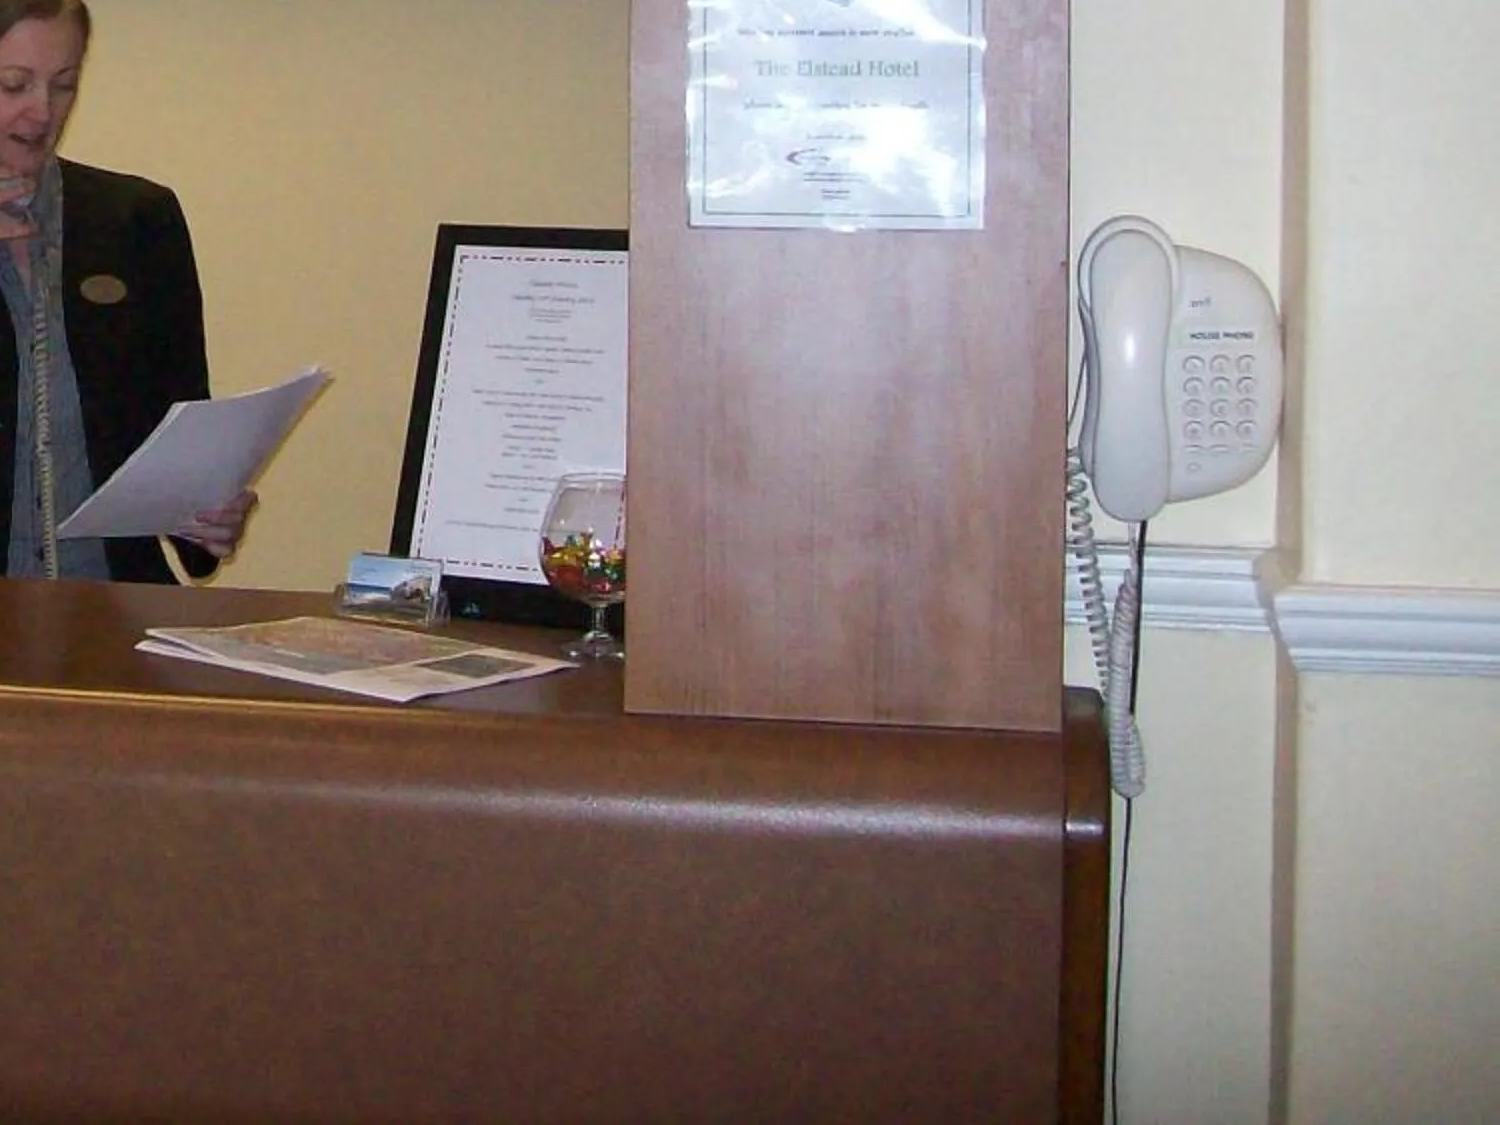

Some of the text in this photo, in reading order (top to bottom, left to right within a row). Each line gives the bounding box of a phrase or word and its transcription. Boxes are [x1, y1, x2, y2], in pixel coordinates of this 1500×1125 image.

[754, 59, 921, 78] The Elstead Hotel
